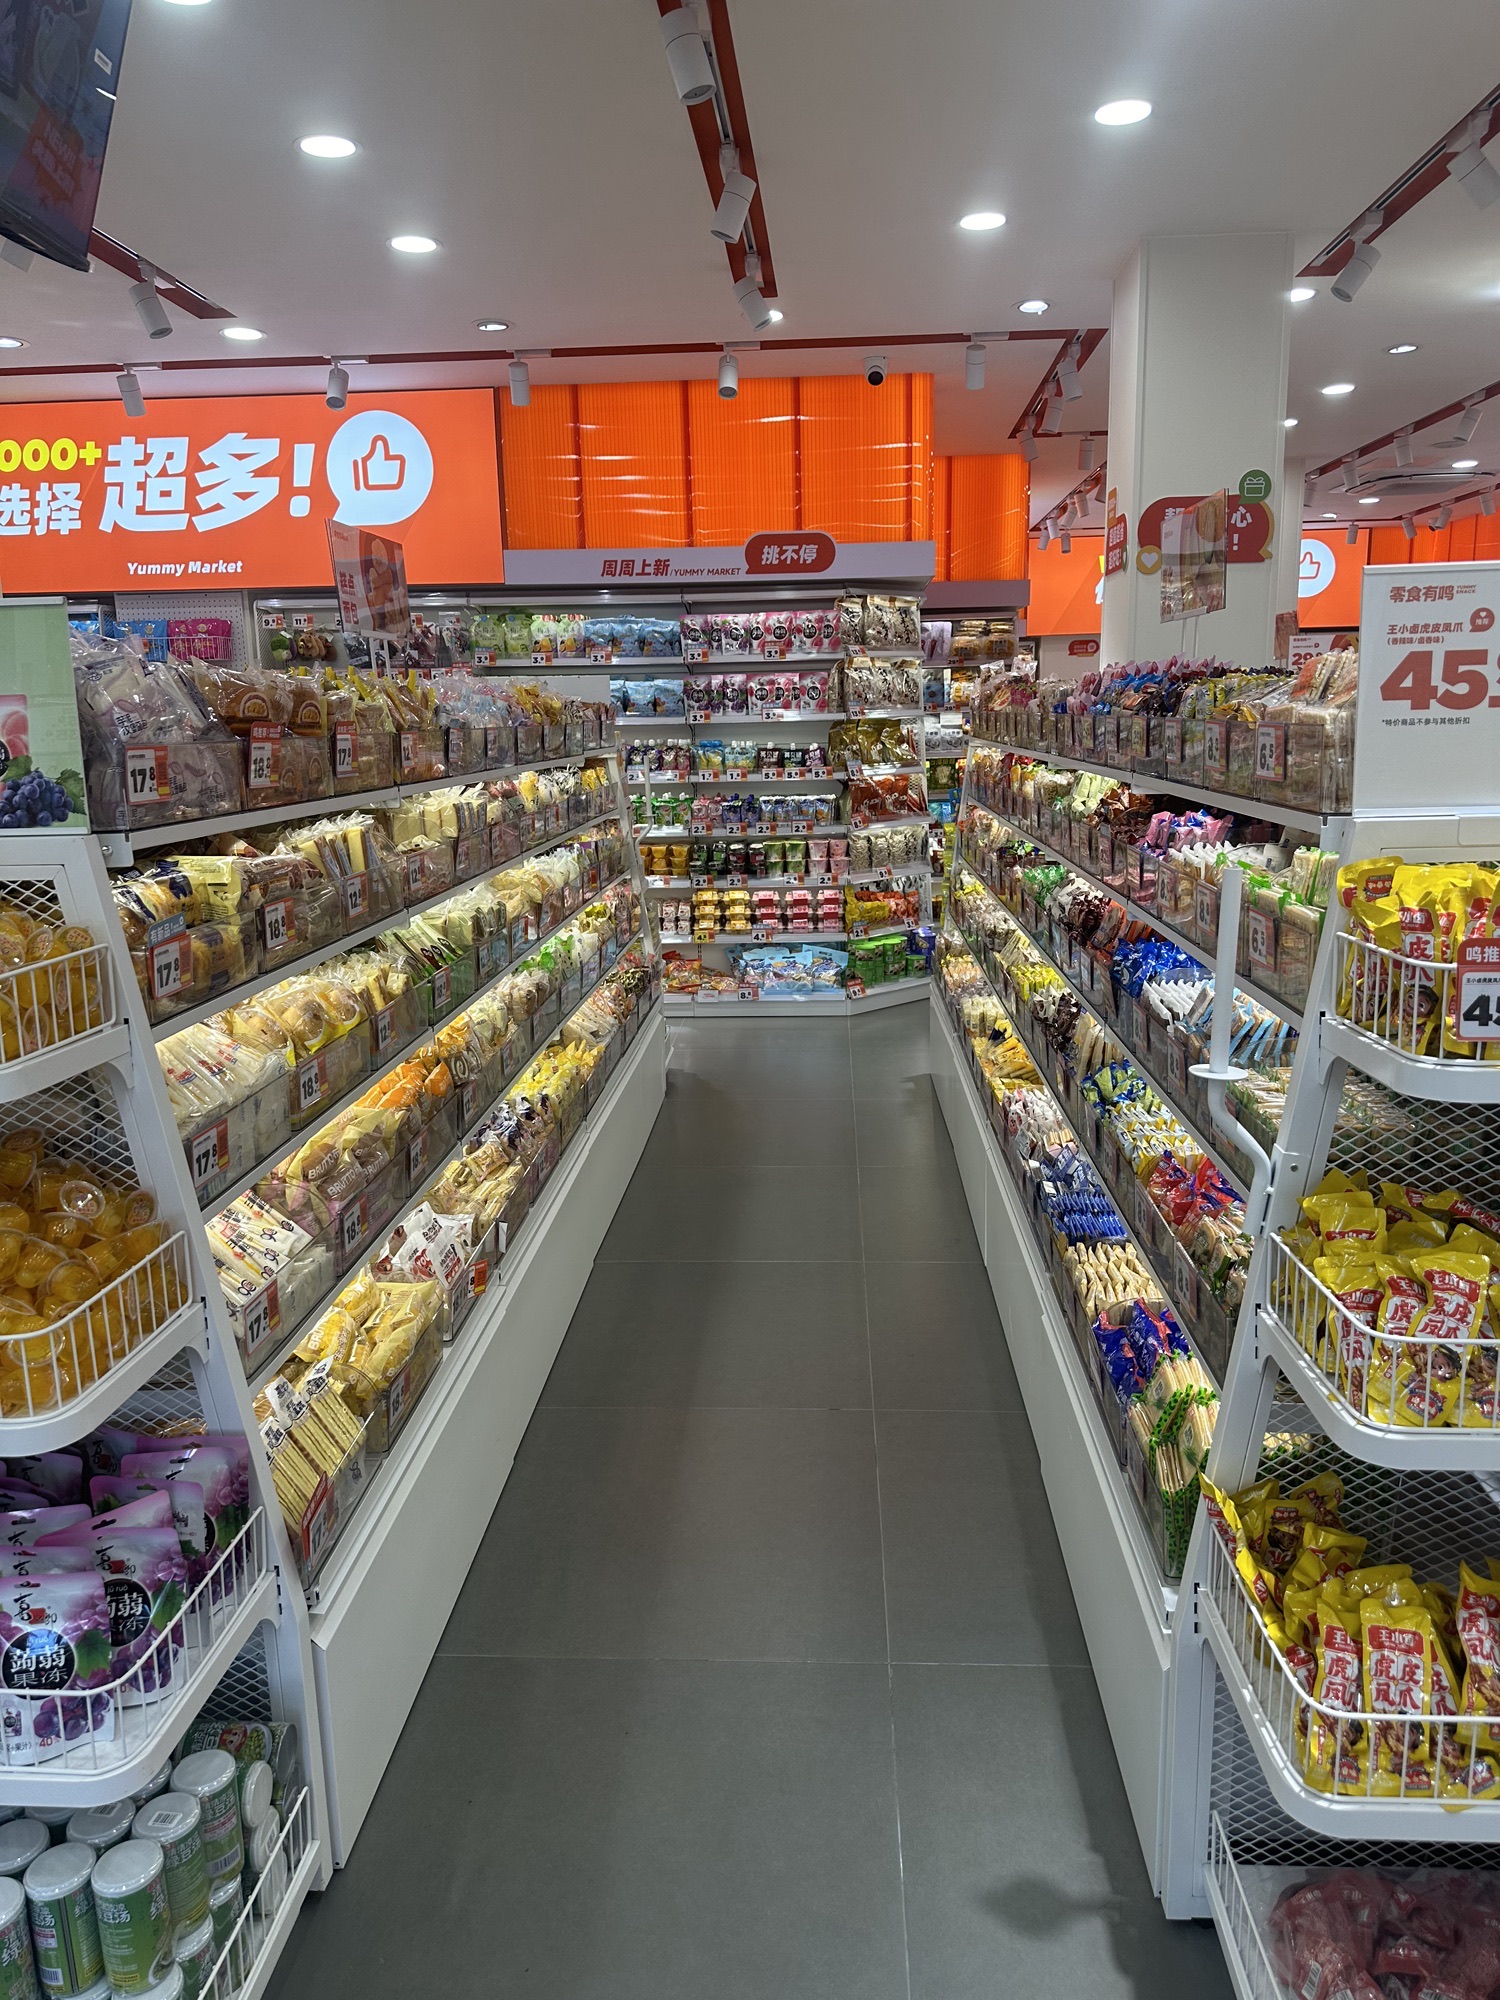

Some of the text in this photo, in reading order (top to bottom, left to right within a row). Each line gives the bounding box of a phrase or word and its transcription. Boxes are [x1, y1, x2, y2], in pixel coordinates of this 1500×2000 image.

[99, 432, 316, 534] 超多!
[0, 482, 83, 536] 选择
[761, 543, 820, 566] 挑不停
[126, 558, 244, 577] Yummy Market
[600, 557, 670, 579] 周周上新
[706, 566, 742, 577] MARKET
[1387, 622, 1464, 636] 王小卤虎皮凤爪
[1373, 1652, 1422, 1686] 虎皮
[1374, 1681, 1421, 1710] 凤爪
[100, 1910, 131, 1924] 豆汤
